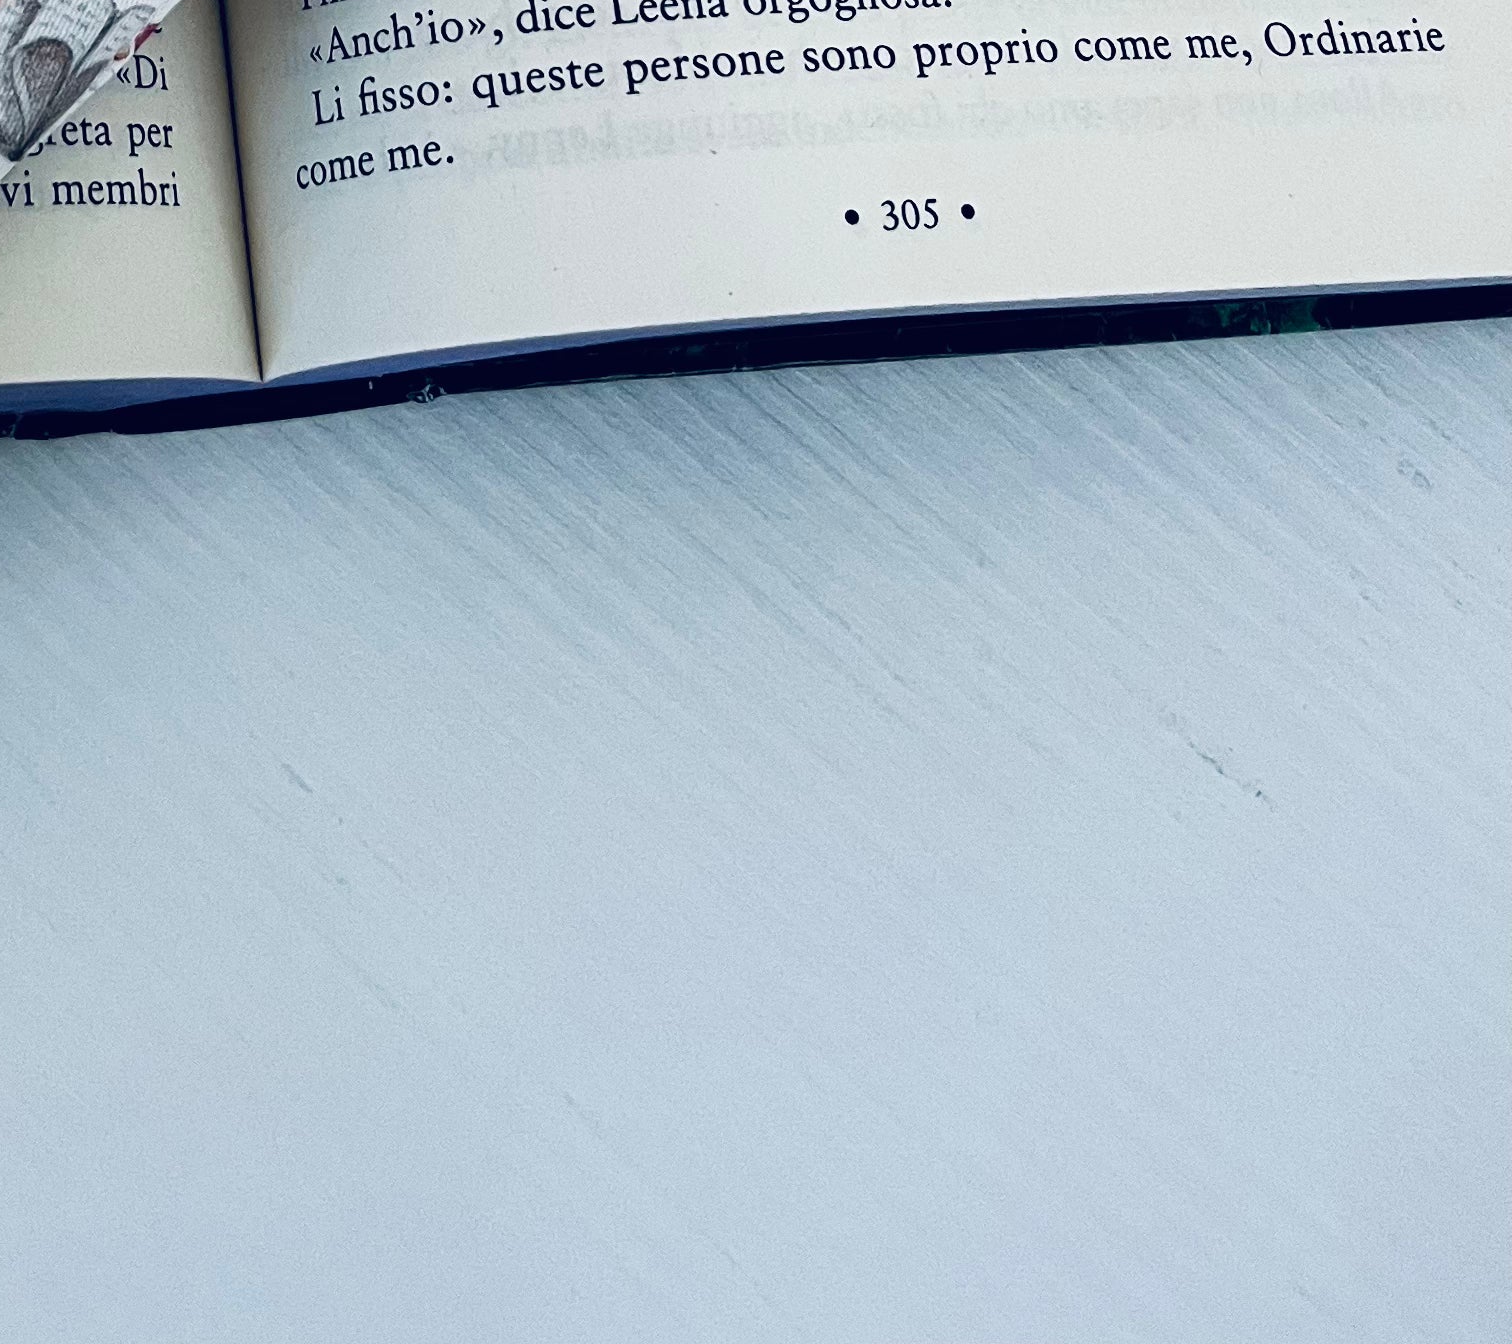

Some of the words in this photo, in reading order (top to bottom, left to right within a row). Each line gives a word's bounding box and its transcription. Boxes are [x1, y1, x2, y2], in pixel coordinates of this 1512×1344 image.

[311, 84, 346, 127] Li
[358, 75, 453, 117] fisso:
[472, 60, 605, 109] queste
[622, 49, 786, 96] persone
[802, 44, 897, 73] sono
[912, 28, 1059, 79] proprio
[1074, 35, 1172, 62] come
[1184, 34, 1253, 67] me,
[1263, 18, 1446, 58] Ordinarie
[126, 122, 173, 158] per
[51, 167, 181, 207] membri
[880, 198, 939, 232] 305
